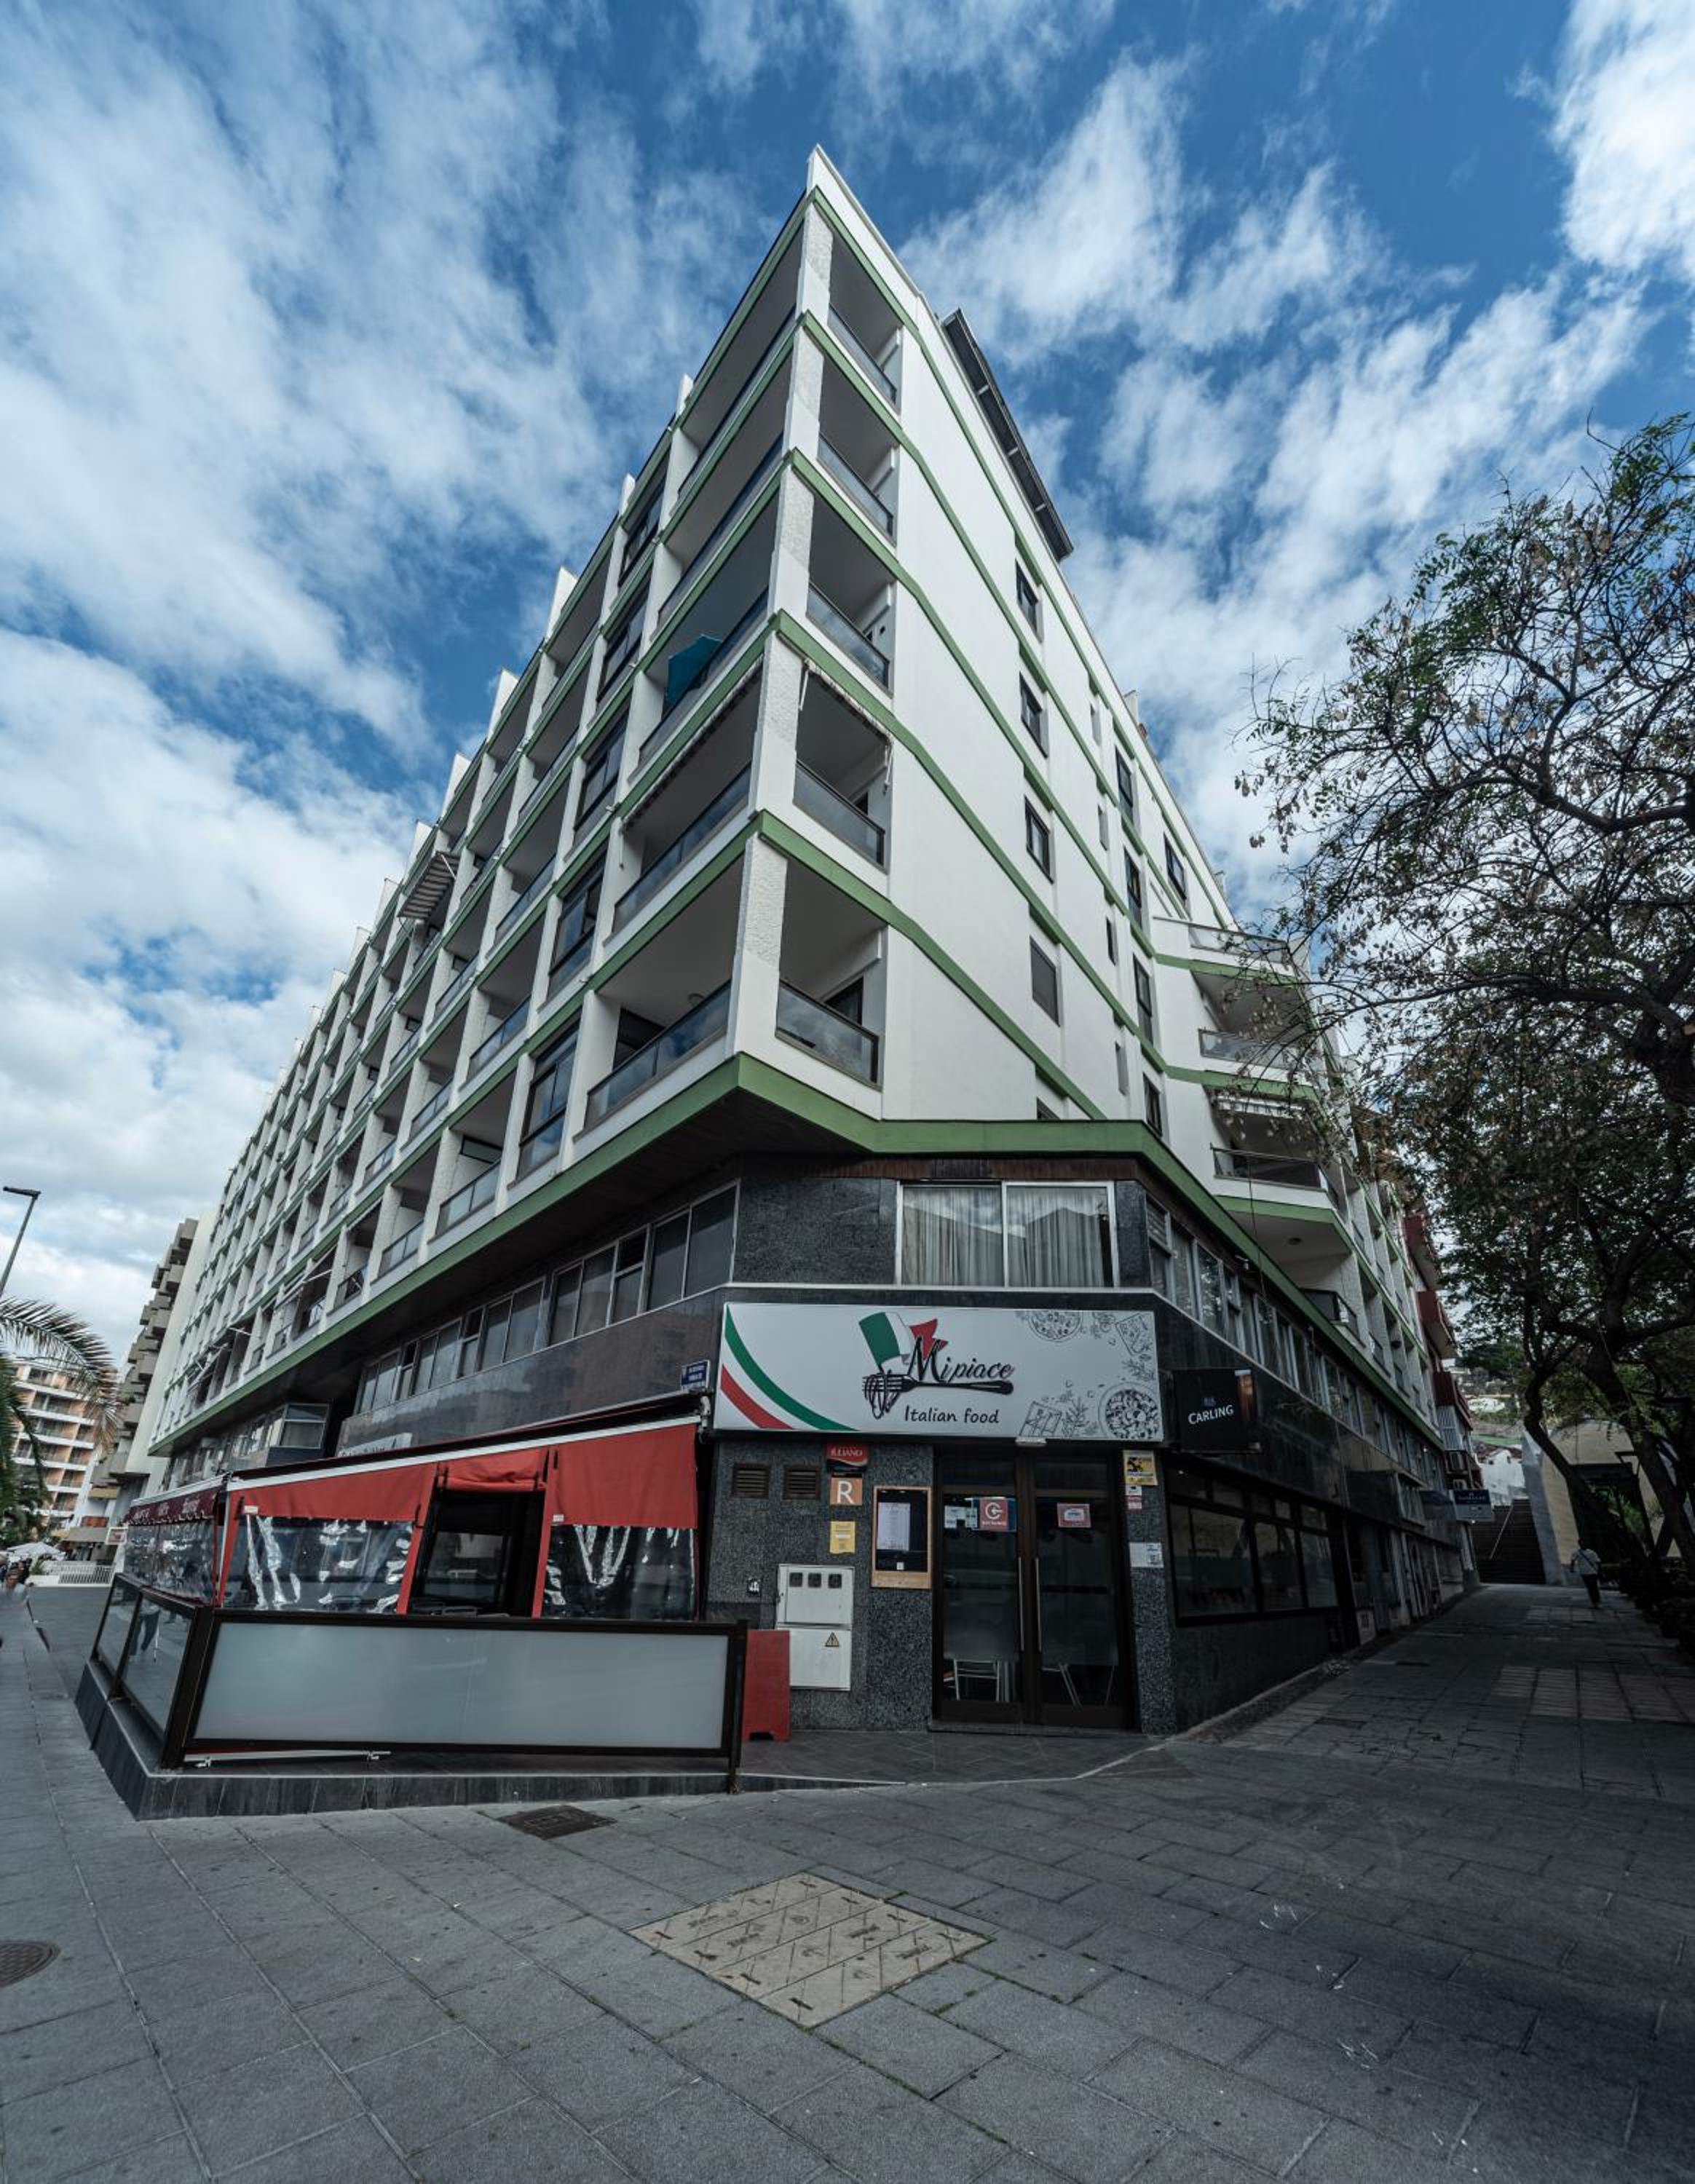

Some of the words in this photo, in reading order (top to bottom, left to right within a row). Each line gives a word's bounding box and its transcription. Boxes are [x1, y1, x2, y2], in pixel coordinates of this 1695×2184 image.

[947, 1357, 1015, 1384] piace
[904, 1405, 957, 1423] Italian
[964, 1408, 1000, 1424] food
[1188, 1404, 1234, 1425] CARLING
[837, 1480, 854, 1504] R
